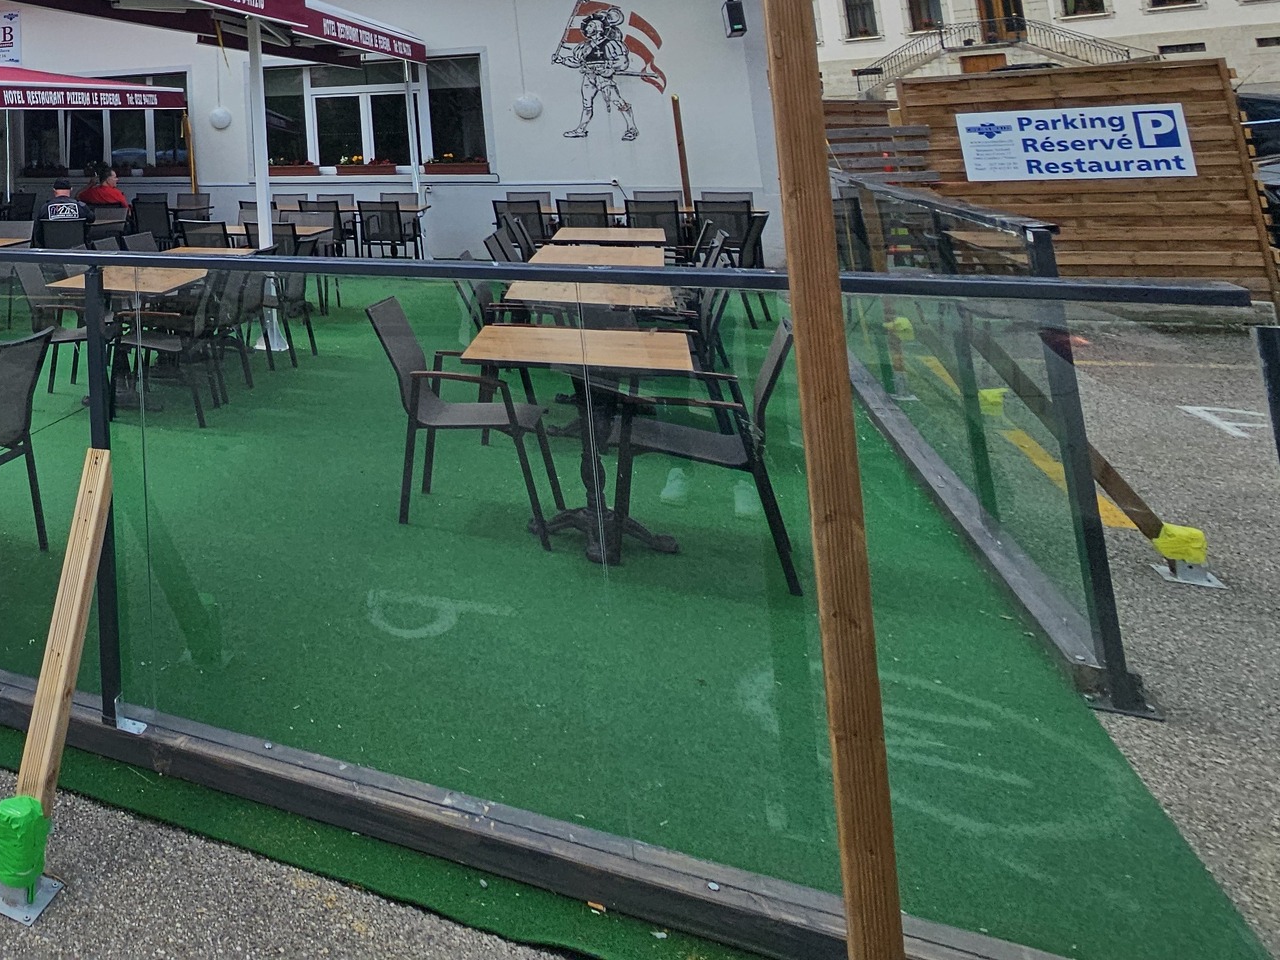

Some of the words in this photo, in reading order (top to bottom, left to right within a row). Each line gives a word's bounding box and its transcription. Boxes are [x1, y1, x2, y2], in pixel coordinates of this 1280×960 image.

[3, 90, 25, 105] HOTEL
[26, 90, 65, 106] RESTAURANT
[67, 92, 90, 106] PIZZERIA
[92, 93, 99, 105] LE
[100, 93, 121, 106] FEDERAL
[1017, 114, 1126, 132] Parking
[1021, 133, 1133, 152] Réservé
[1025, 155, 1186, 175] Restaurant
